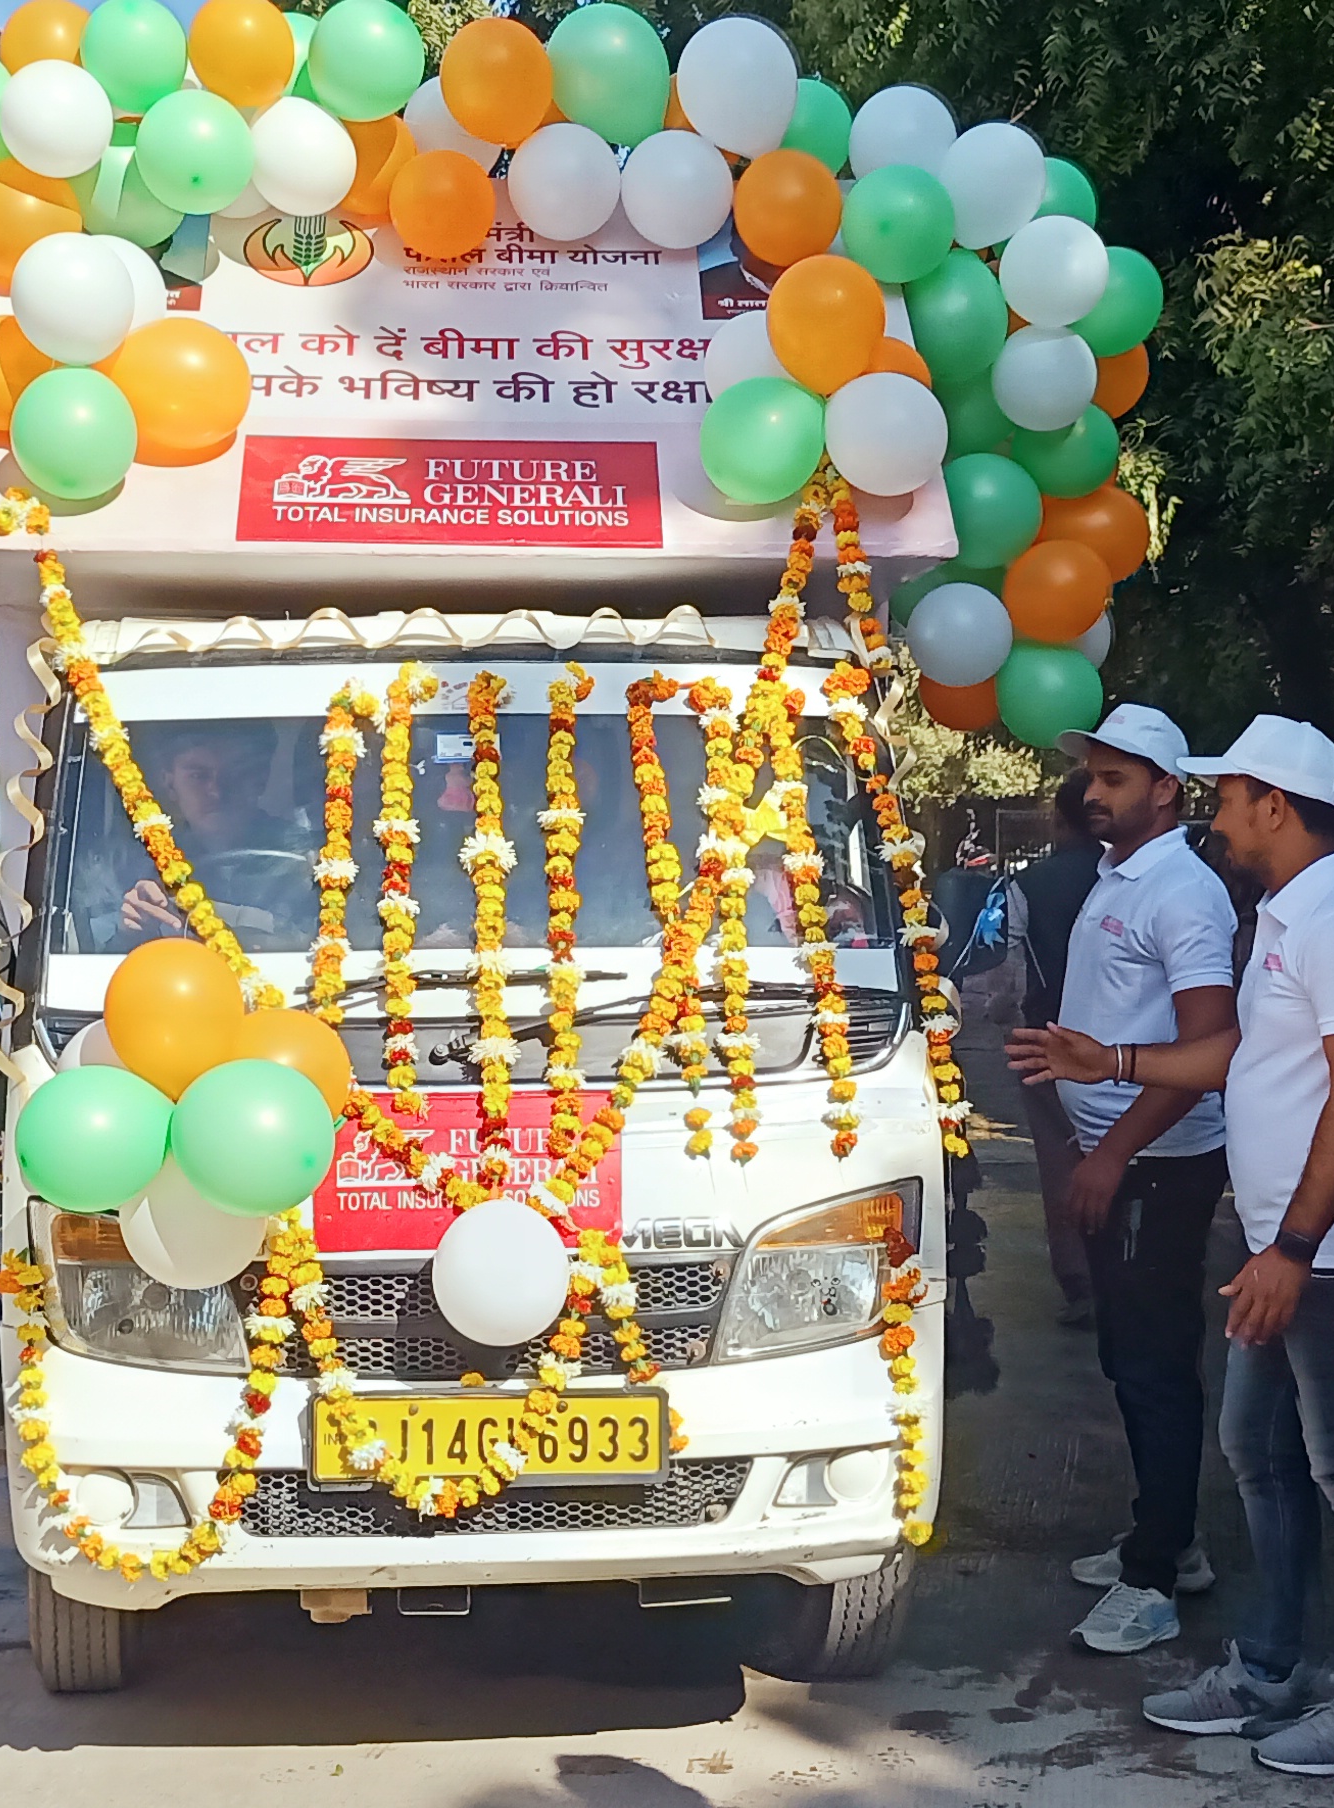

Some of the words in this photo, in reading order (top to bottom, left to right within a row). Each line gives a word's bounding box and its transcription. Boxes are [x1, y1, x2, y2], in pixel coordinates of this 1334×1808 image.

[495, 244, 559, 264] बीमा
[568, 244, 663, 266] योजना
[404, 266, 469, 276] राजस्थान
[476, 268, 524, 277] सरकार
[403, 280, 439, 289] भारत
[447, 281, 496, 290] सरकार
[298, 325, 360, 356] को
[373, 326, 407, 361] दें
[420, 328, 520, 360] बीमा
[532, 330, 594, 360] की
[338, 369, 480, 402] भविष्य
[492, 371, 555, 402] की
[568, 371, 618, 408] हो
[424, 459, 597, 482] FUTURE
[423, 483, 628, 508] GENERALI
[273, 505, 347, 523] TOTAL
[354, 507, 490, 525] INSURANCE
[497, 510, 629, 527] SOLUTIONS
[336, 1191, 393, 1211] TOTAL
